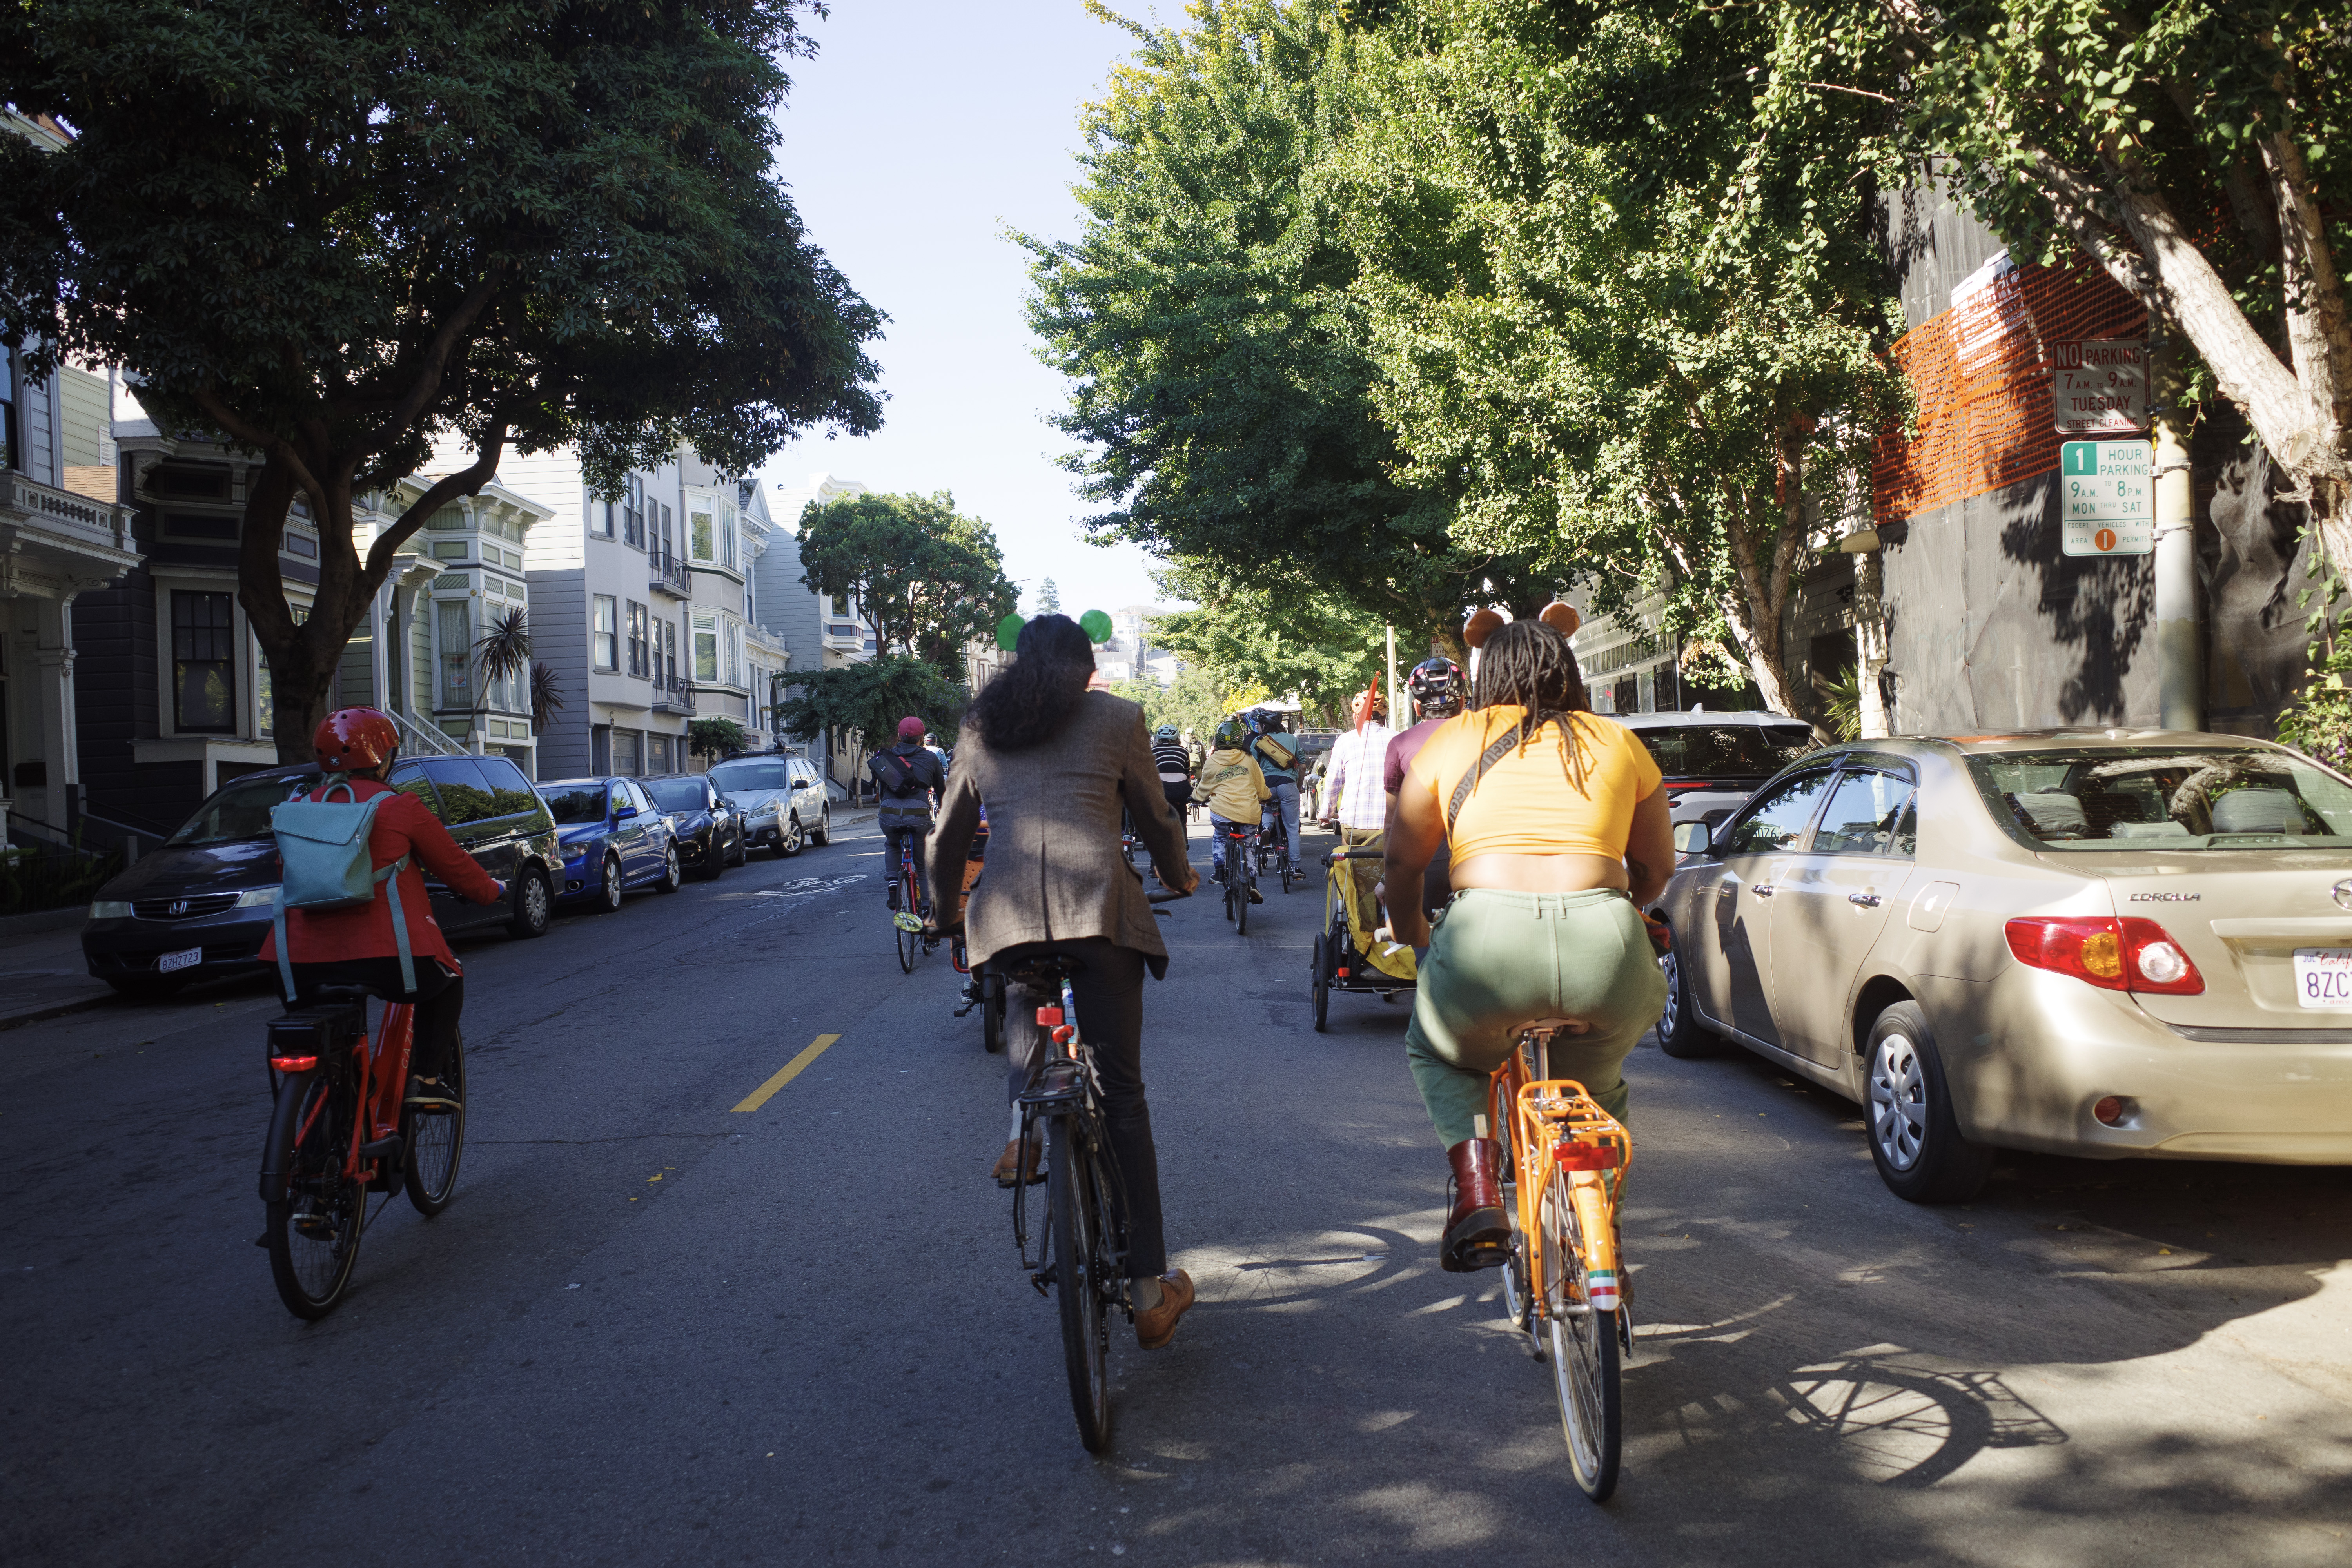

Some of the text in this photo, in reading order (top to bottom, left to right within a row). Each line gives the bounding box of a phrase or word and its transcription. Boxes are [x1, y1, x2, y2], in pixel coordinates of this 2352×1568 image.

[2057, 344, 2140, 367] NO PARKING
[2064, 373, 2074, 390] 7
[2076, 380, 2092, 389] A.M.
[2108, 371, 2117, 388] 9
[2120, 379, 2136, 387] A.M.
[2071, 396, 2131, 412] TUESDAY
[2067, 417, 2138, 428] STREET CLEANING
[2076, 448, 2142, 470] 1 HOUR
[2100, 464, 2148, 476] PARKING
[2071, 481, 2080, 498] 9
[2081, 489, 2098, 497] A.M.
[2118, 480, 2126, 497] 8
[2128, 488, 2144, 496] P.M.
[2073, 503, 2096, 514] MON
[2122, 501, 2141, 513] SAT
[1483, 726, 1518, 766] AGGU
[2129, 893, 2201, 902] COROLLA
[162, 951, 199, 970] 8ZHZ723
[2320, 952, 2352, 969] Calif
[2307, 971, 2352, 998] 8ZC
